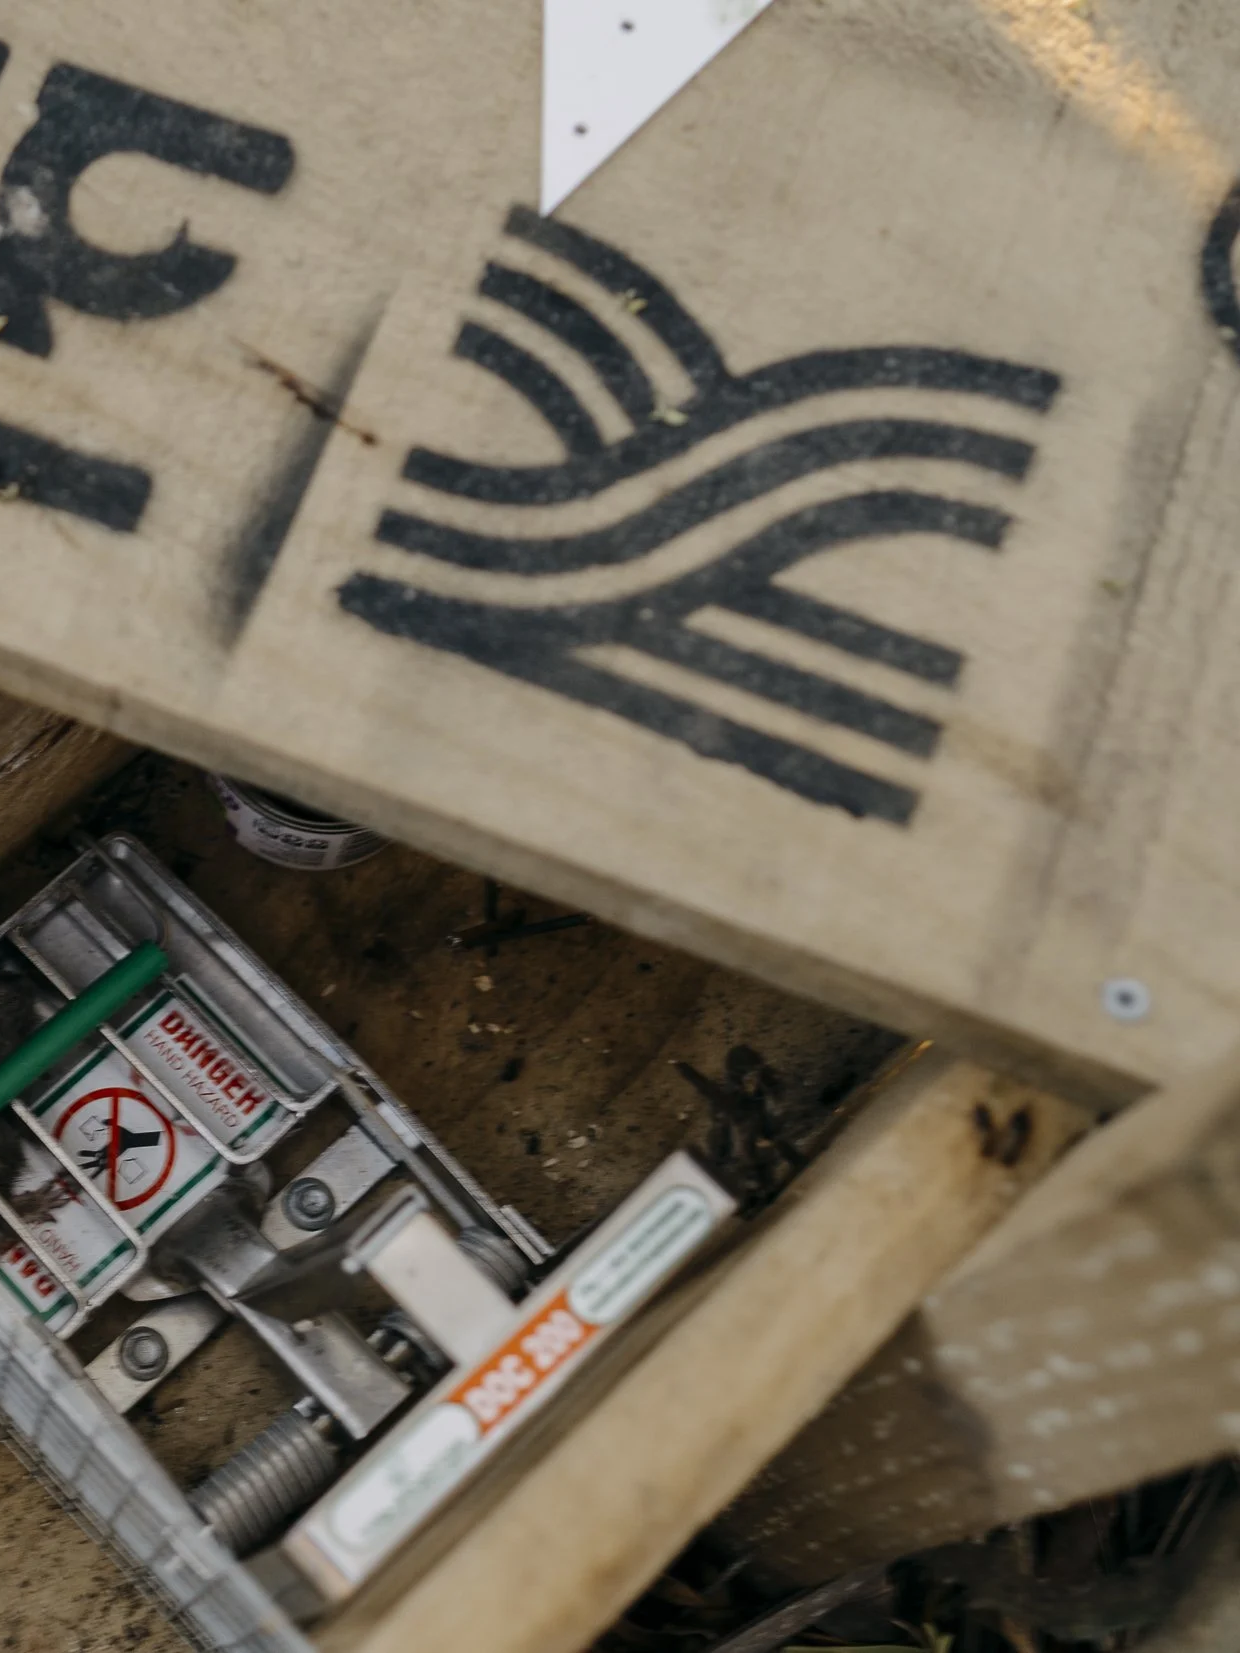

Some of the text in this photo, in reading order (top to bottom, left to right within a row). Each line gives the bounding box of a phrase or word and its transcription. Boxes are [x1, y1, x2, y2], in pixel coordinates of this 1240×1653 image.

[143, 1028, 241, 1130] HAND HAZARD
[158, 1010, 268, 1116] DANGER
[462, 1306, 585, 1423] DOC 200
